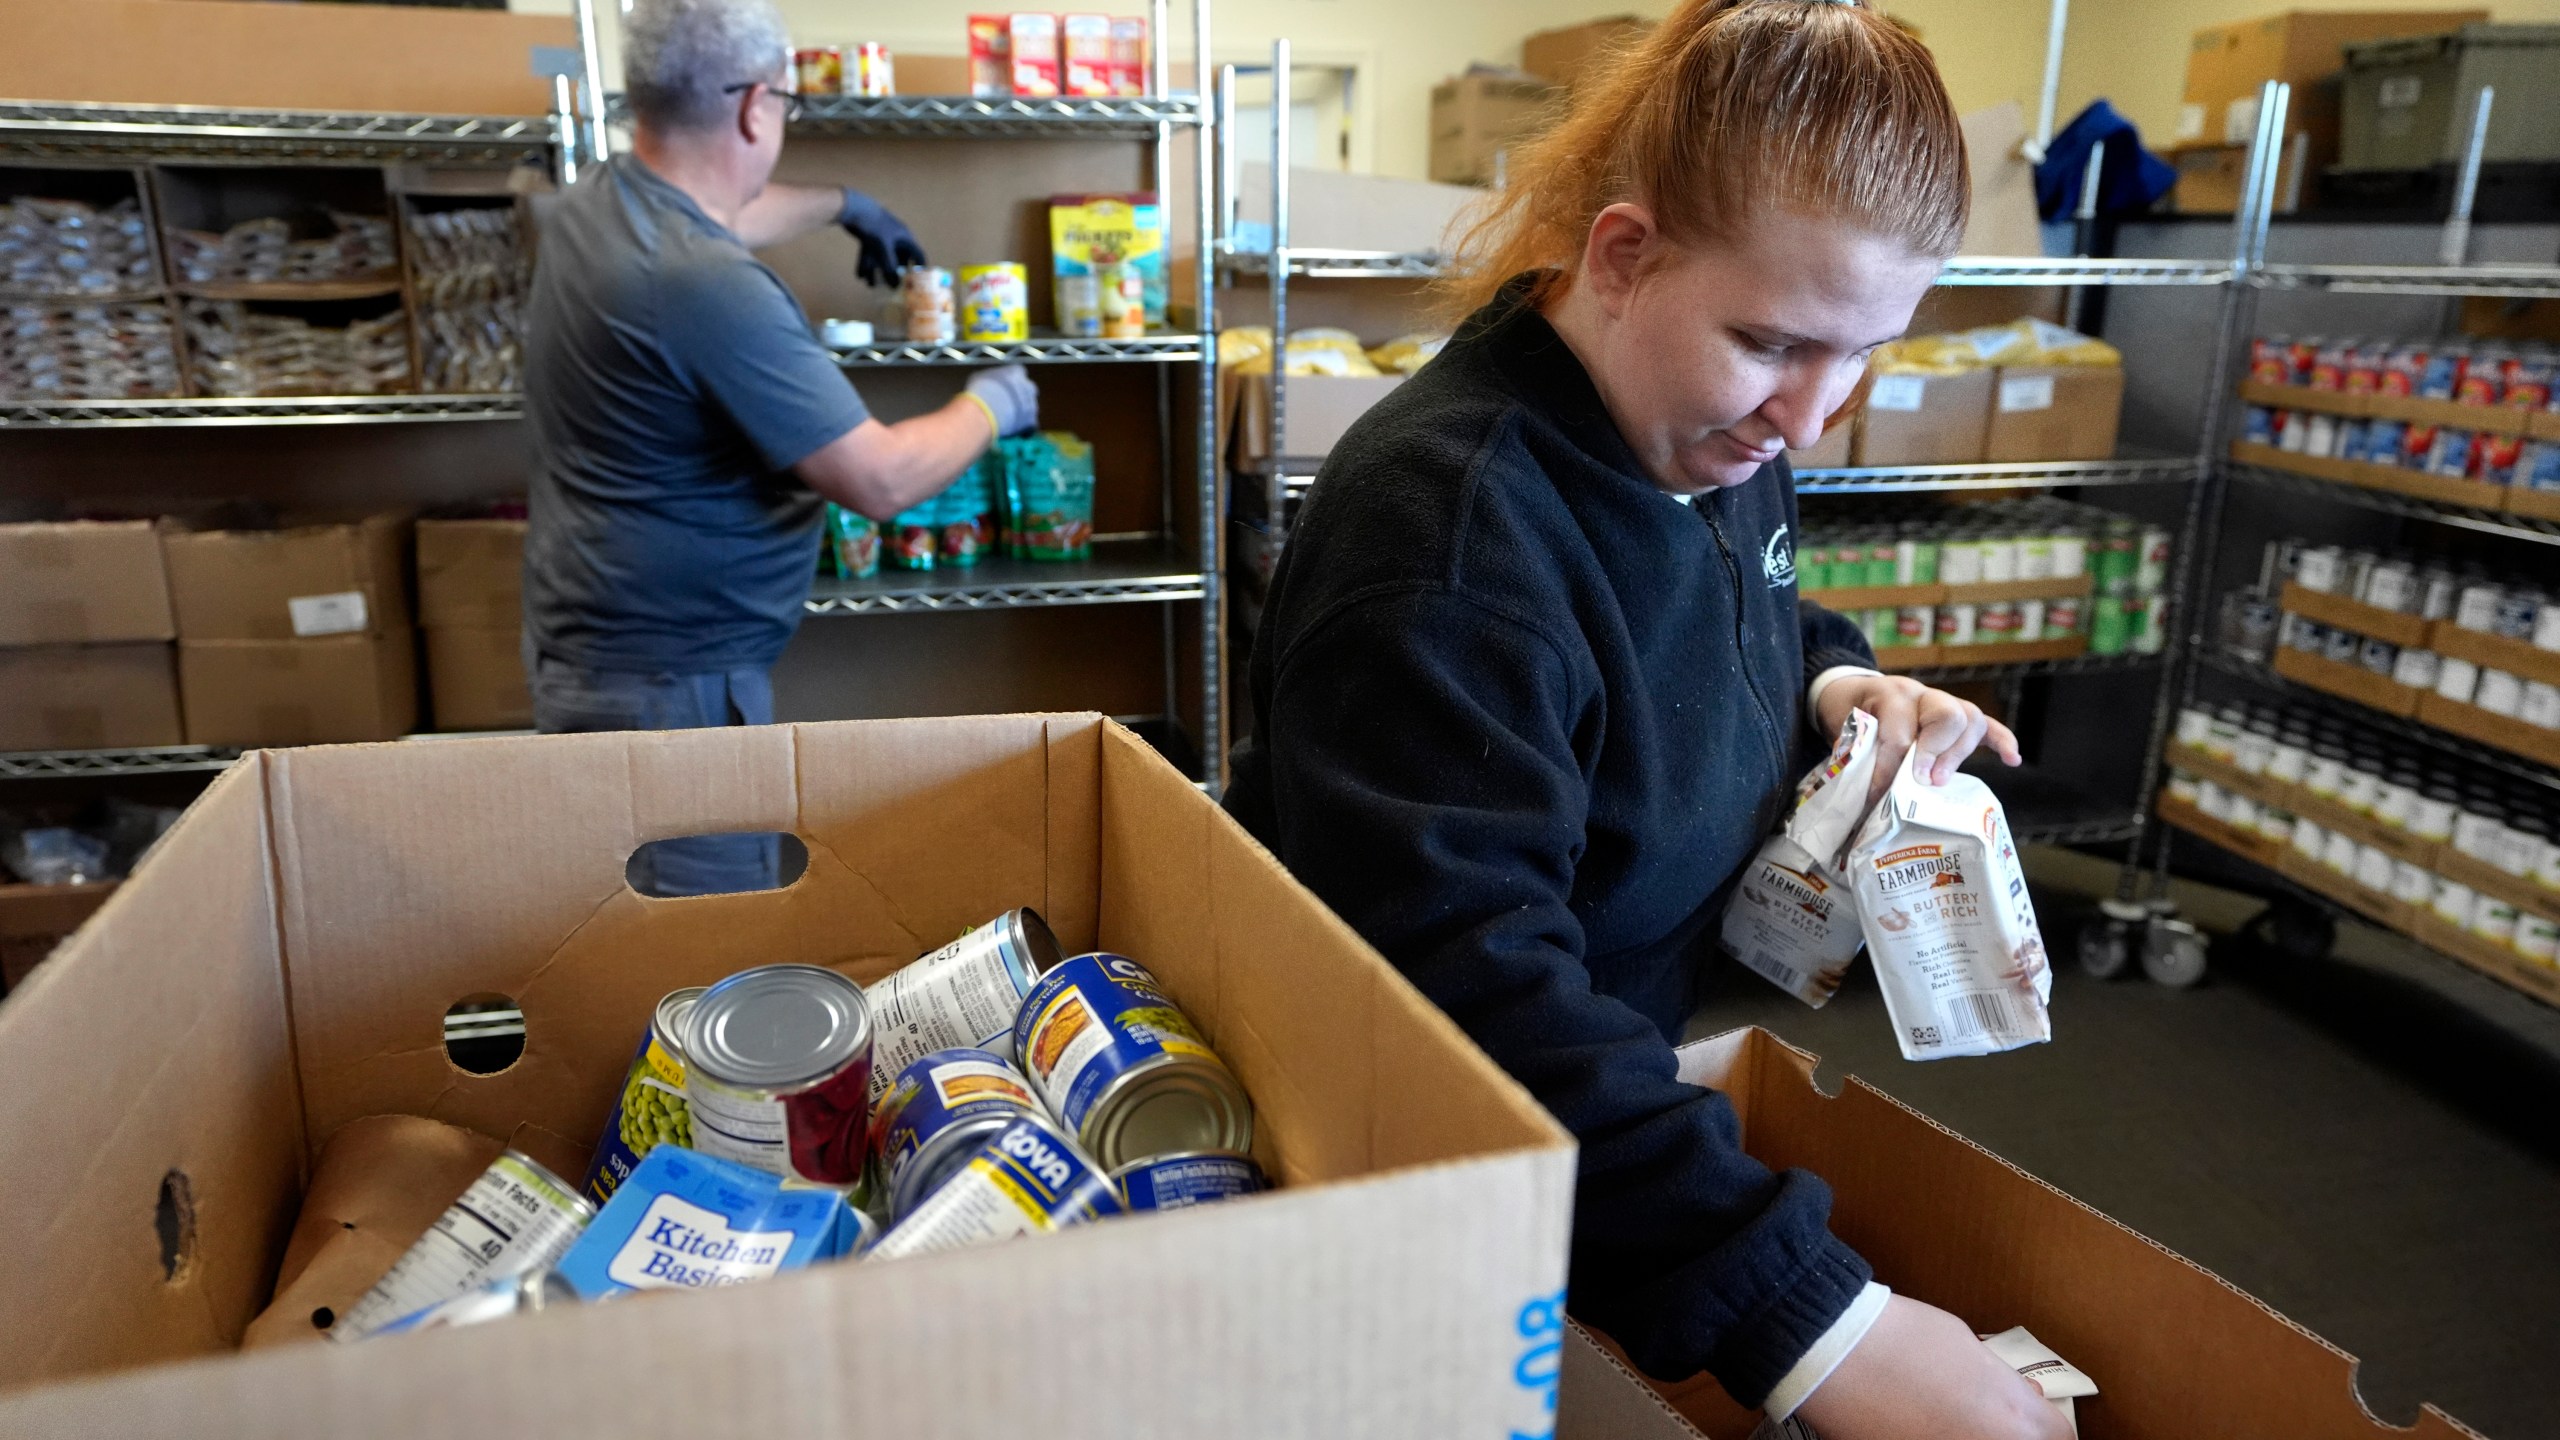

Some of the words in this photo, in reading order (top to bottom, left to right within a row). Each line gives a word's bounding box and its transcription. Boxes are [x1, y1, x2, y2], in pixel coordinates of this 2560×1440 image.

[1879, 848, 1915, 865] PEPPERIDGE
[1917, 847, 1936, 855] FARM
[1877, 853, 1961, 890] FARMHOUSE
[1760, 865, 1834, 915] FARMHOUSE
[1913, 891, 1979, 913] BUTTERY
[1773, 899, 1832, 936] BUTTERY
[1941, 905, 1977, 919] RICH
[1789, 917, 1824, 940] RICH
[1916, 949, 1928, 958] No
[1930, 940, 1966, 954] Artificial
[1922, 962, 1941, 973] Rich
[1932, 970, 1950, 980] Real
[1931, 979, 1949, 989] Real
[906, 1022, 919, 1035] 40
[961, 1011, 981, 1041] MICROWAVE
[973, 1005, 992, 1035] MICROWAVE
[979, 1001, 998, 1031] MICROWAVE
[608, 1151, 630, 1180] des
[1001, 1126, 1071, 1189] GOYA
[505, 1181, 540, 1215] Facts
[477, 1236, 504, 1262] 40
[646, 1216, 776, 1265] Kitchen
[2044, 1366, 2068, 1374] THIN
